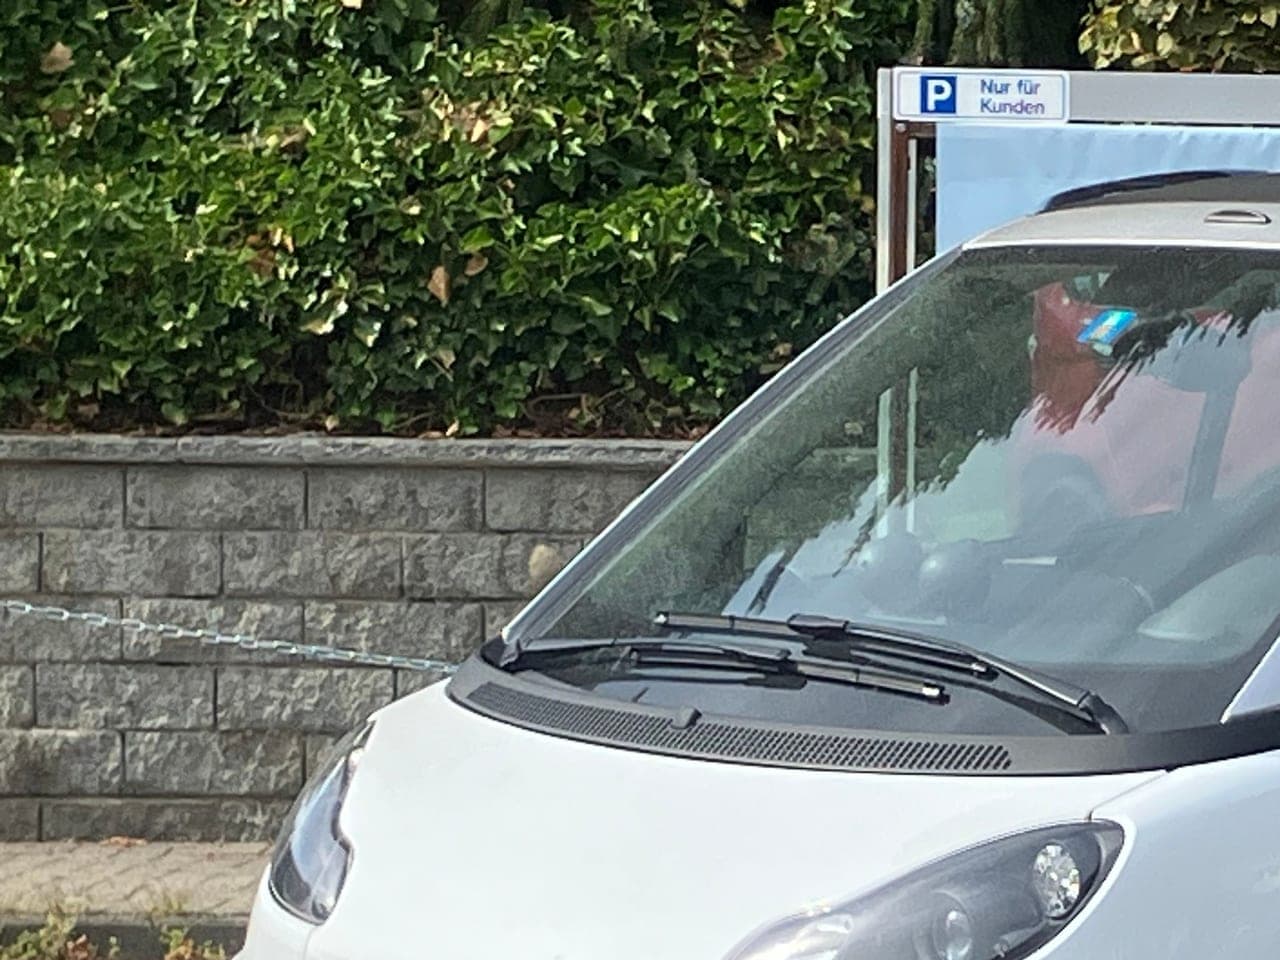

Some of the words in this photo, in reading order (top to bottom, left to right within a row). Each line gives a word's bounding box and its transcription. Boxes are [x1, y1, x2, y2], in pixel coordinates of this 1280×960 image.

[926, 79, 952, 112] P
[980, 79, 1011, 95] Nur
[1017, 79, 1041, 95] für
[980, 98, 1046, 115] Kunden
